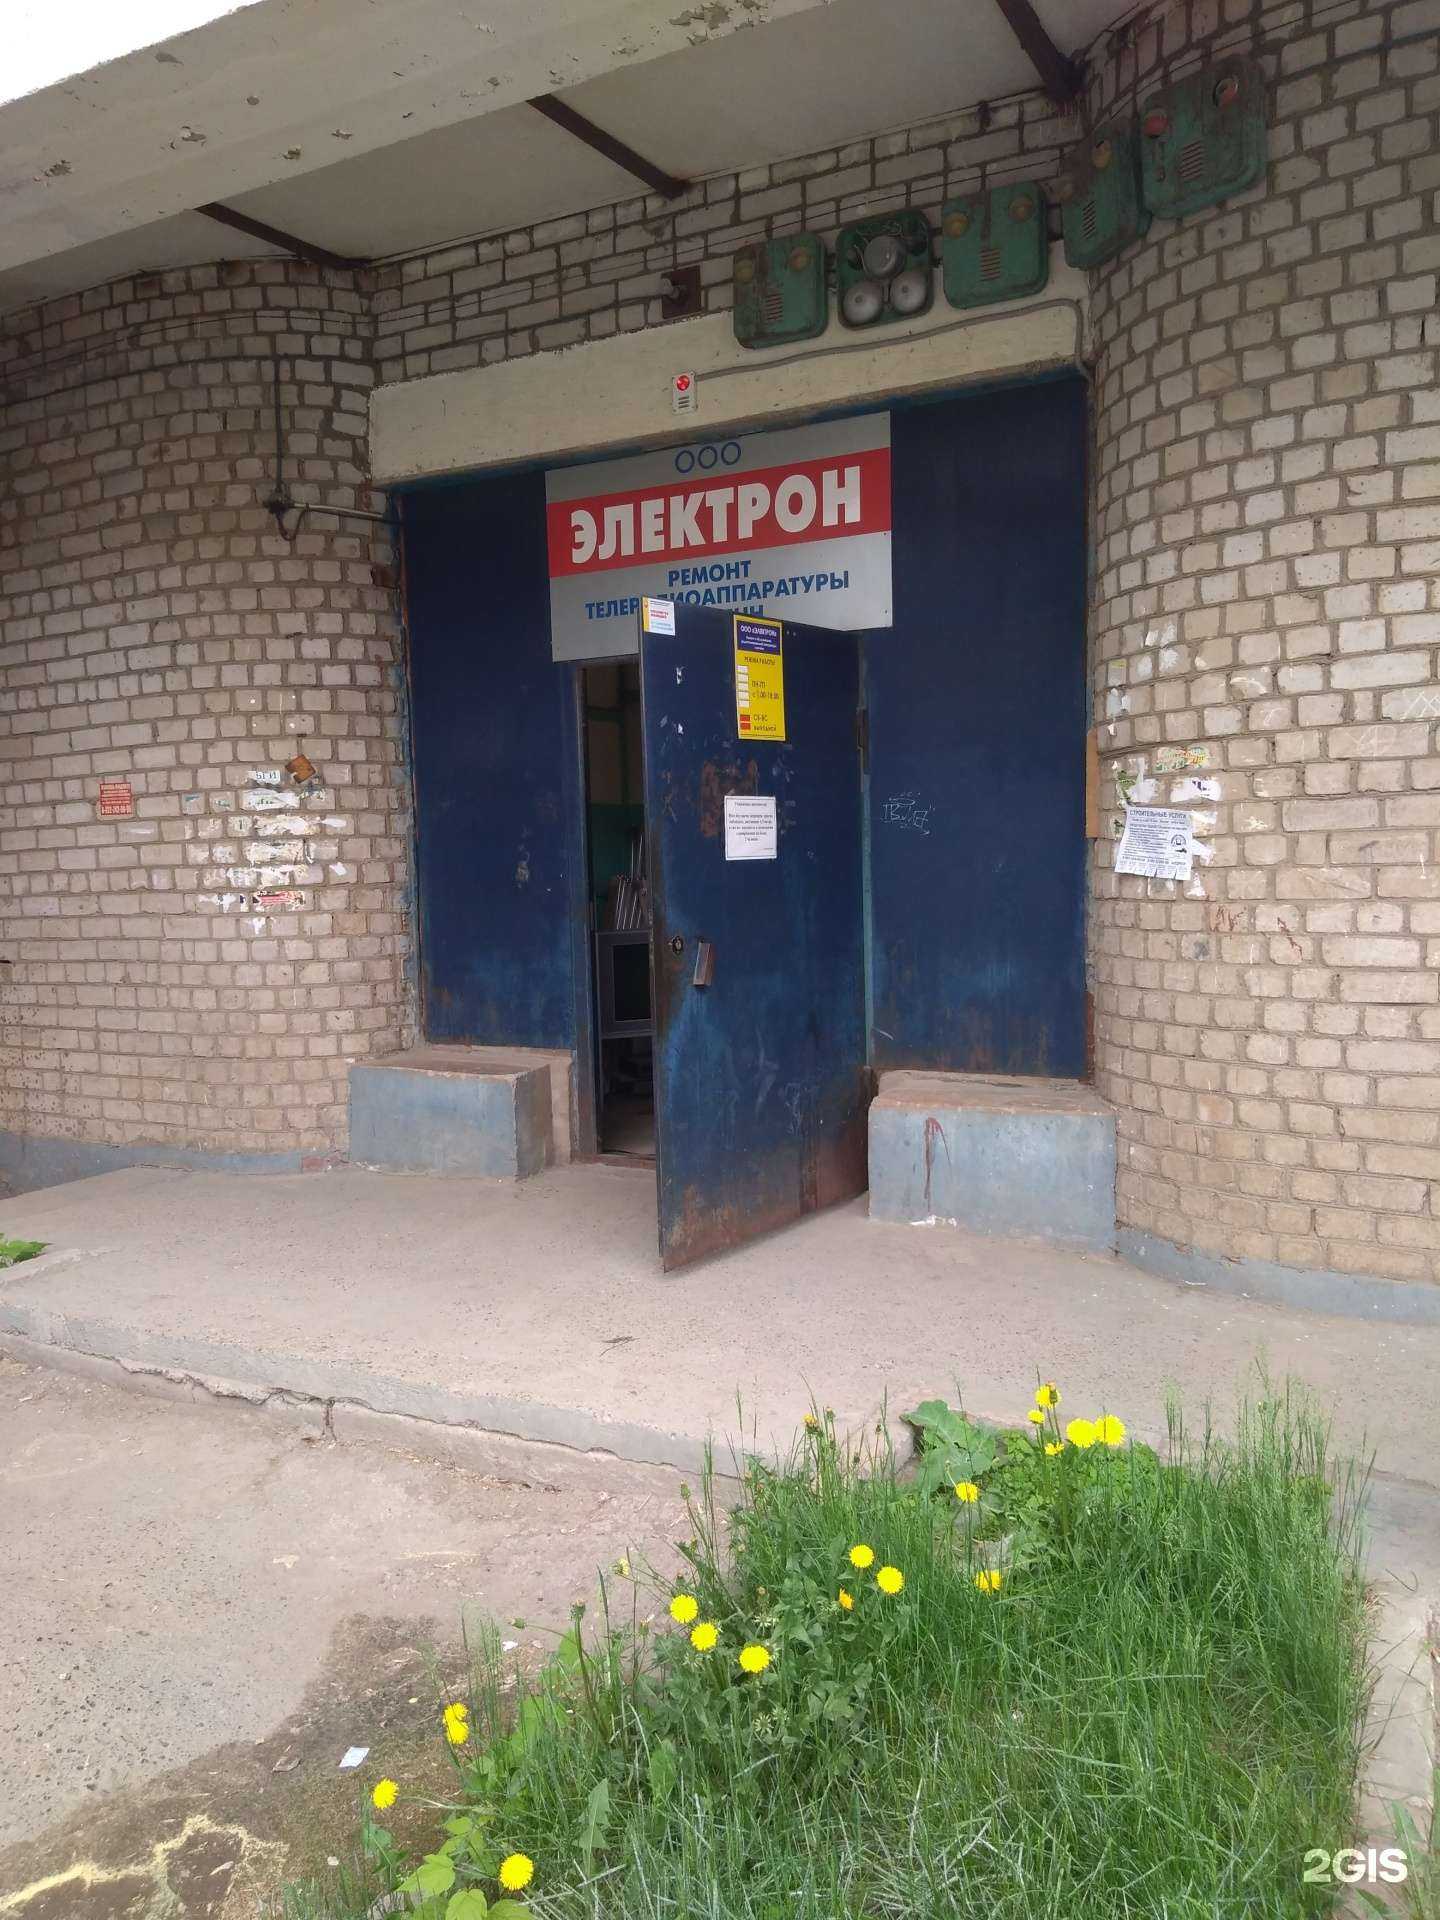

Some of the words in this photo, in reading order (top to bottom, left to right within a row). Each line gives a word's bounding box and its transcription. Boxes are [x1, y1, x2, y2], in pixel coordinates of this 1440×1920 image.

[675, 441, 742, 474] ООО
[570, 465, 861, 564] ЭЛЕКТРОН
[668, 560, 751, 588] РЕМОНТ
[585, 570, 849, 620] ТЕЛЕРИОАППАРАТУРЫ
